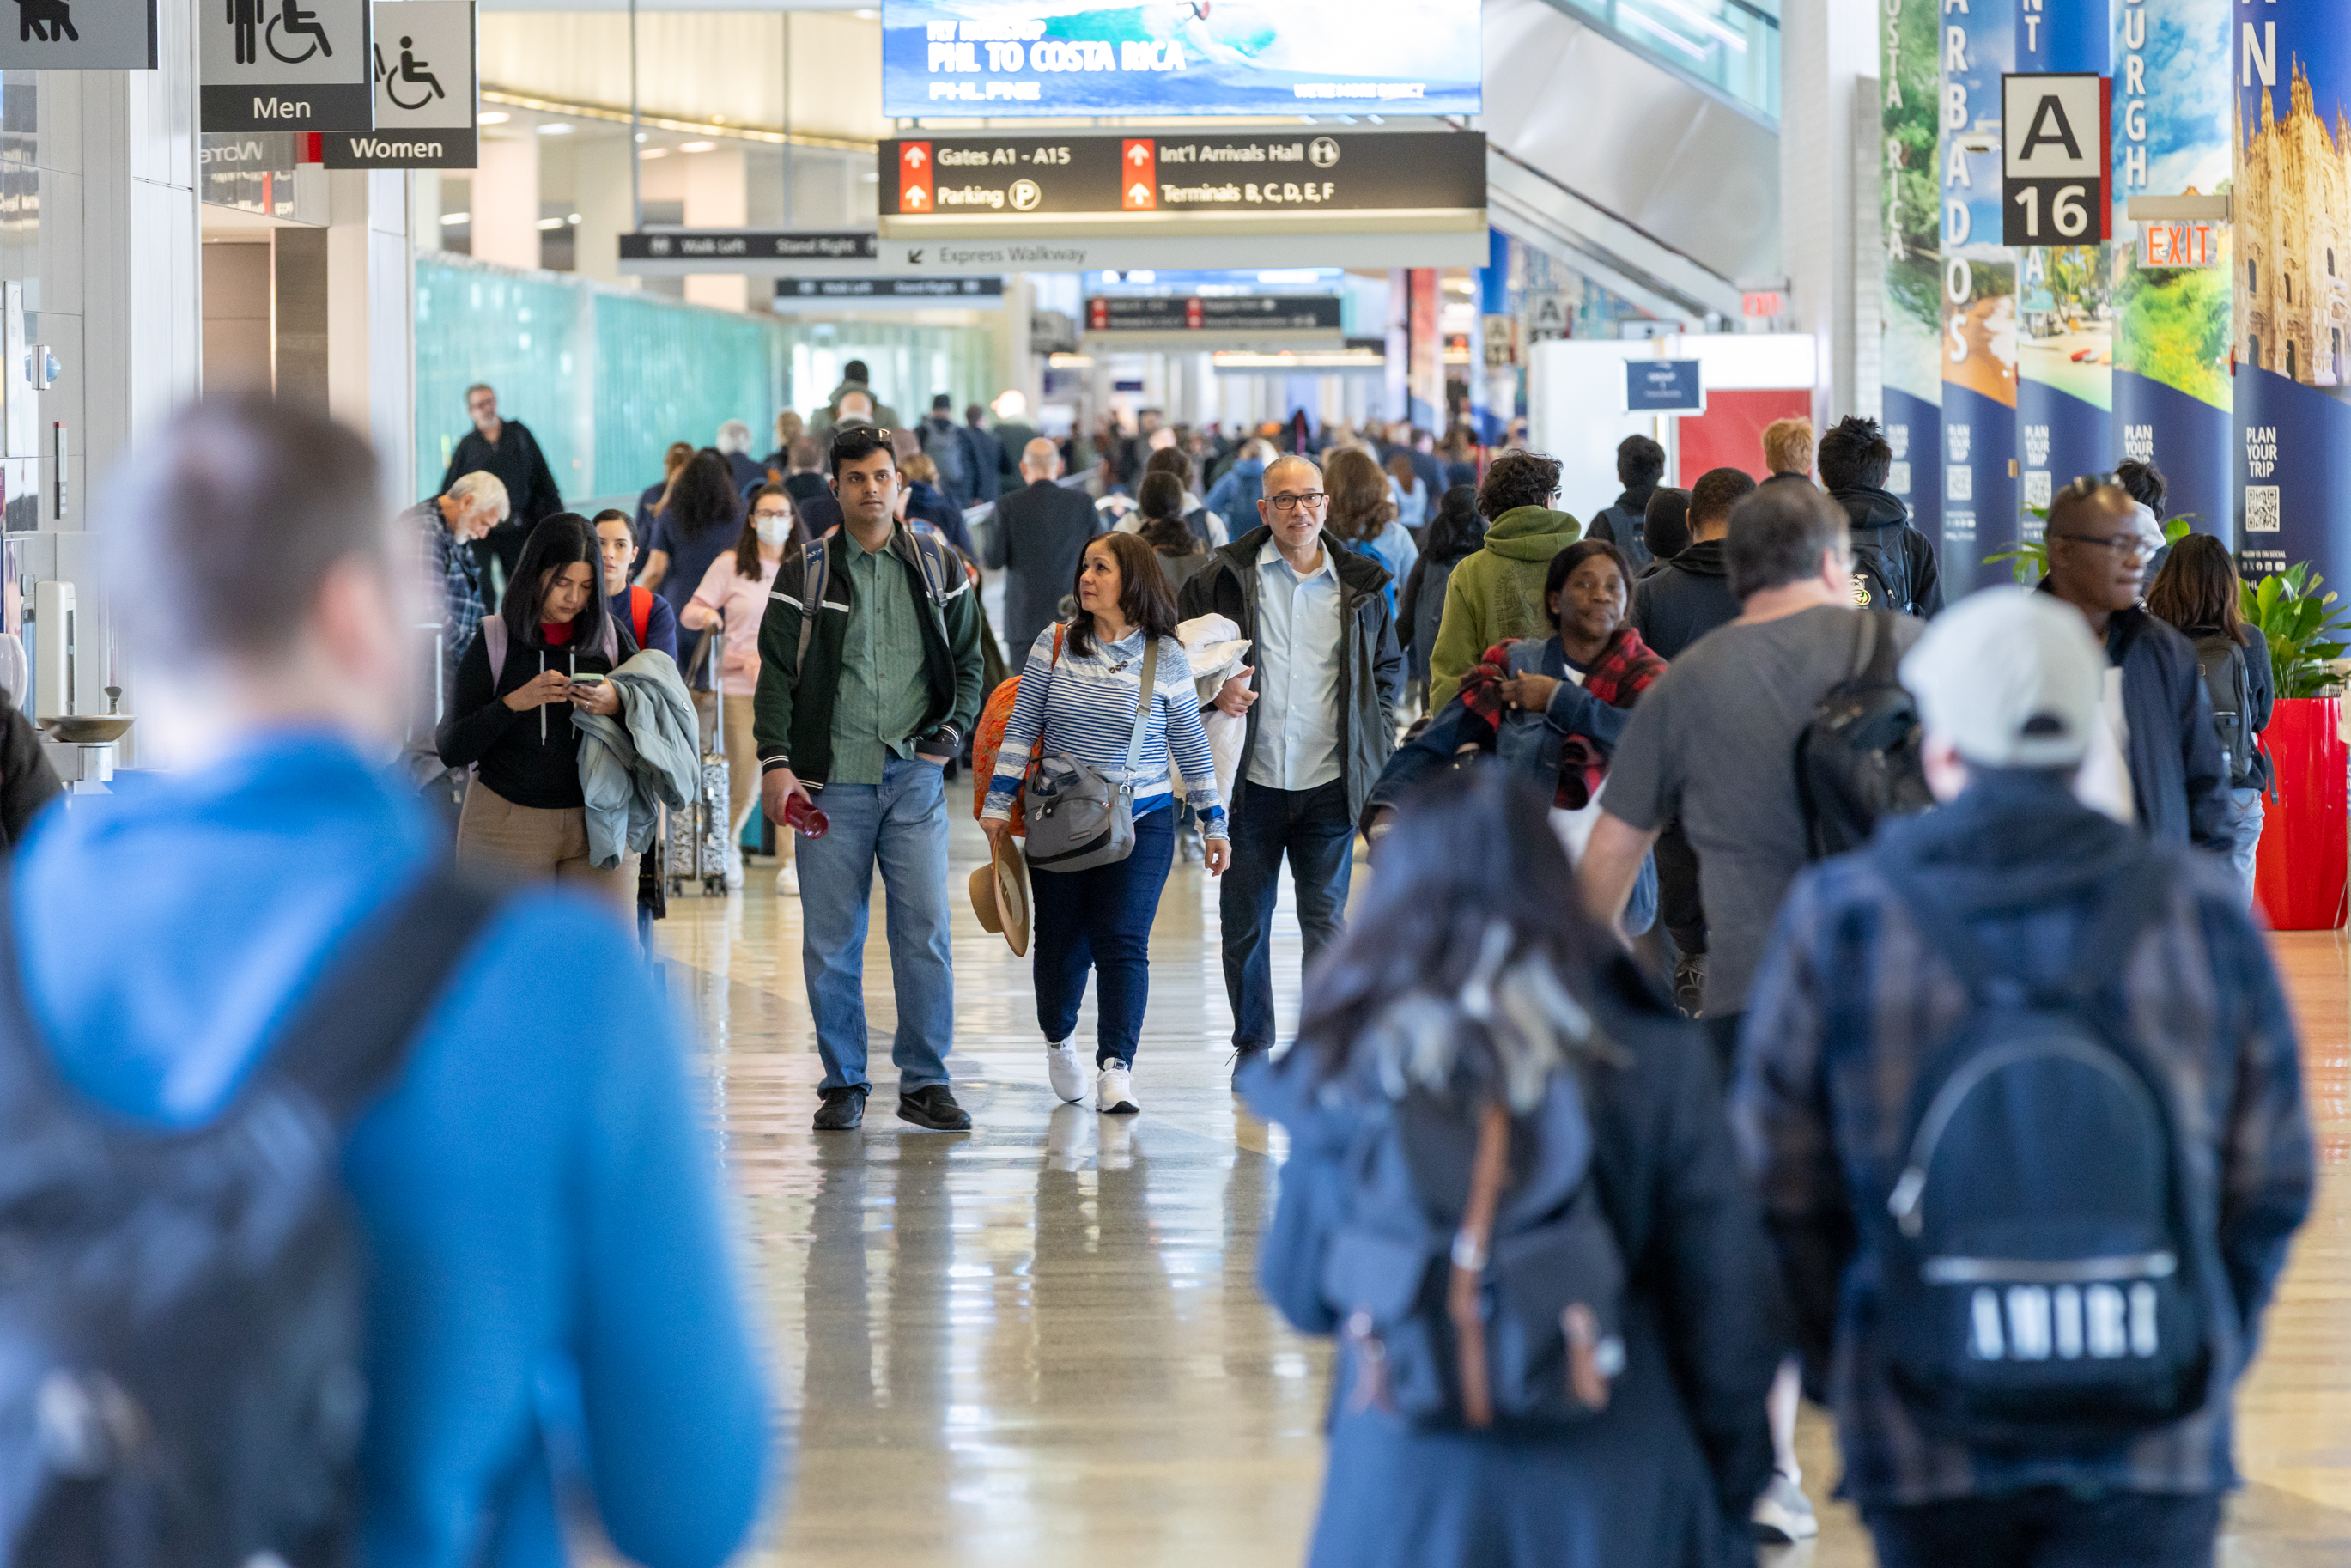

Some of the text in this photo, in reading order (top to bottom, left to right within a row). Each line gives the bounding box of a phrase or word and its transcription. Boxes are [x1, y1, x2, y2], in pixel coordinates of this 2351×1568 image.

[928, 41, 1186, 72] PHL TO COSTA RICA
[2125, 0, 2147, 187] URGH
[253, 97, 311, 119] Men
[2019, 94, 2083, 160] A
[350, 138, 443, 158] Women
[937, 148, 989, 166] Gates
[992, 148, 1016, 165] A1
[1033, 147, 1071, 165] A15
[1160, 143, 1303, 163] Int'l Arrivals Hall
[938, 185, 1005, 209] Parking
[1161, 183, 1241, 203] Terminals
[1888, 140, 1905, 261] RICA
[2015, 185, 2088, 237] 16
[681, 238, 715, 254] Walk
[939, 245, 1087, 264] Express Walkway
[2148, 226, 2210, 264] EXIT
[2025, 425, 2049, 439] PLAN
[2125, 424, 2153, 440] PLAN
[2246, 427, 2276, 443] PLAN
[2026, 439, 2050, 453] YOUR
[2125, 440, 2154, 455] YOUR
[2246, 444, 2277, 460] YOUR
[2027, 453, 2047, 466] TRIP
[2249, 461, 2275, 477] TRIP
